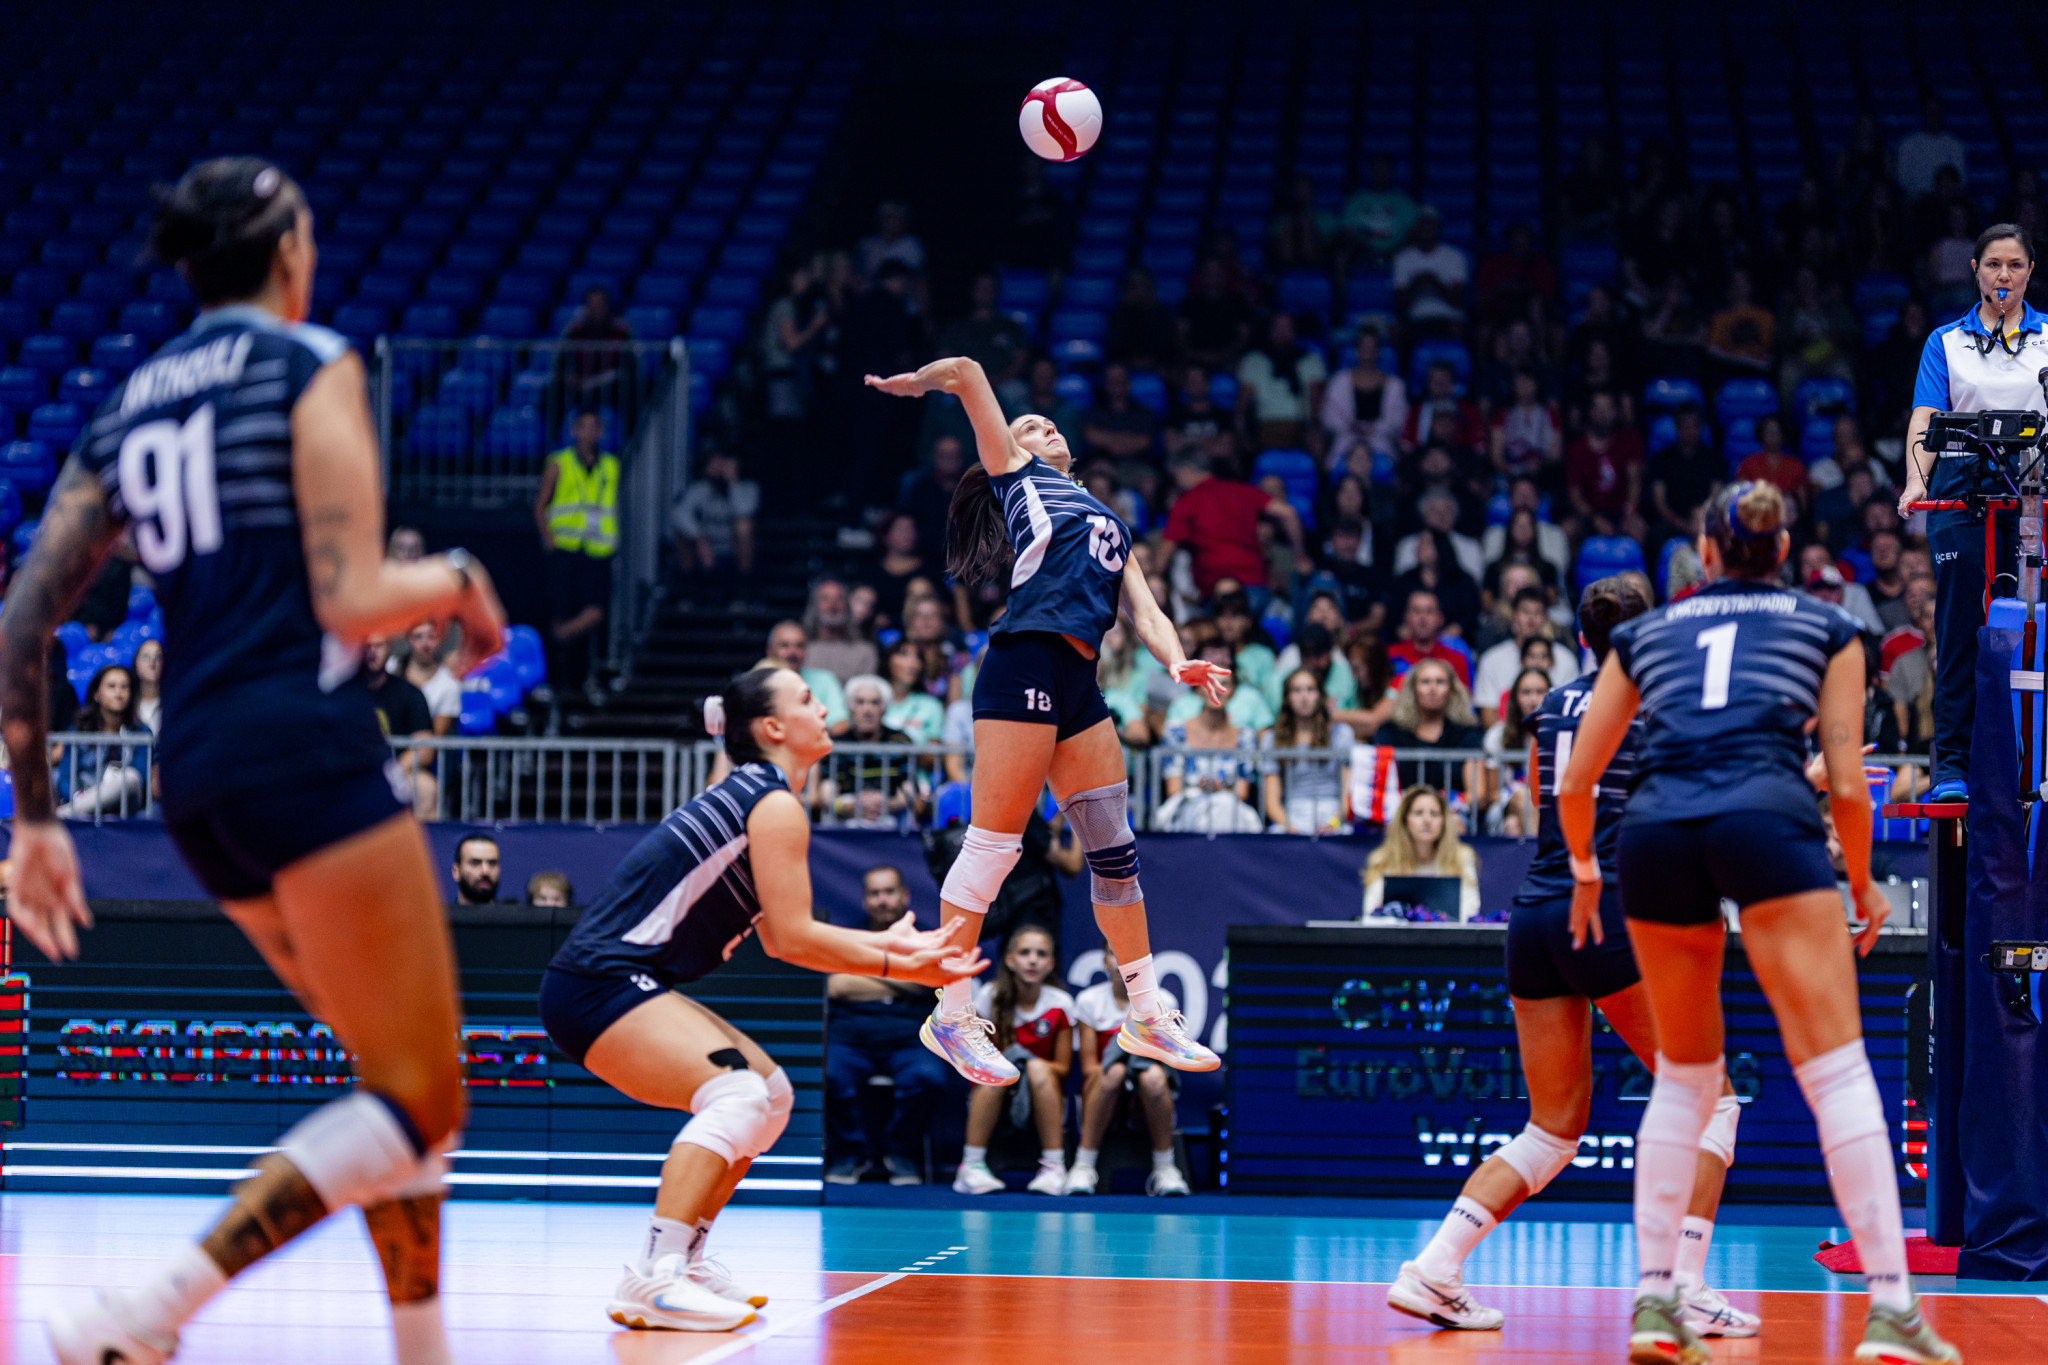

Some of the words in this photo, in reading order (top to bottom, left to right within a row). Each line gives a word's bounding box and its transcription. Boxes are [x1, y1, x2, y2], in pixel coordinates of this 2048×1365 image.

[118, 402, 223, 574] 91
[1940, 551, 1958, 562] CEV
[1697, 621, 1739, 710] 1
[1414, 1114, 1635, 1168] Woen
